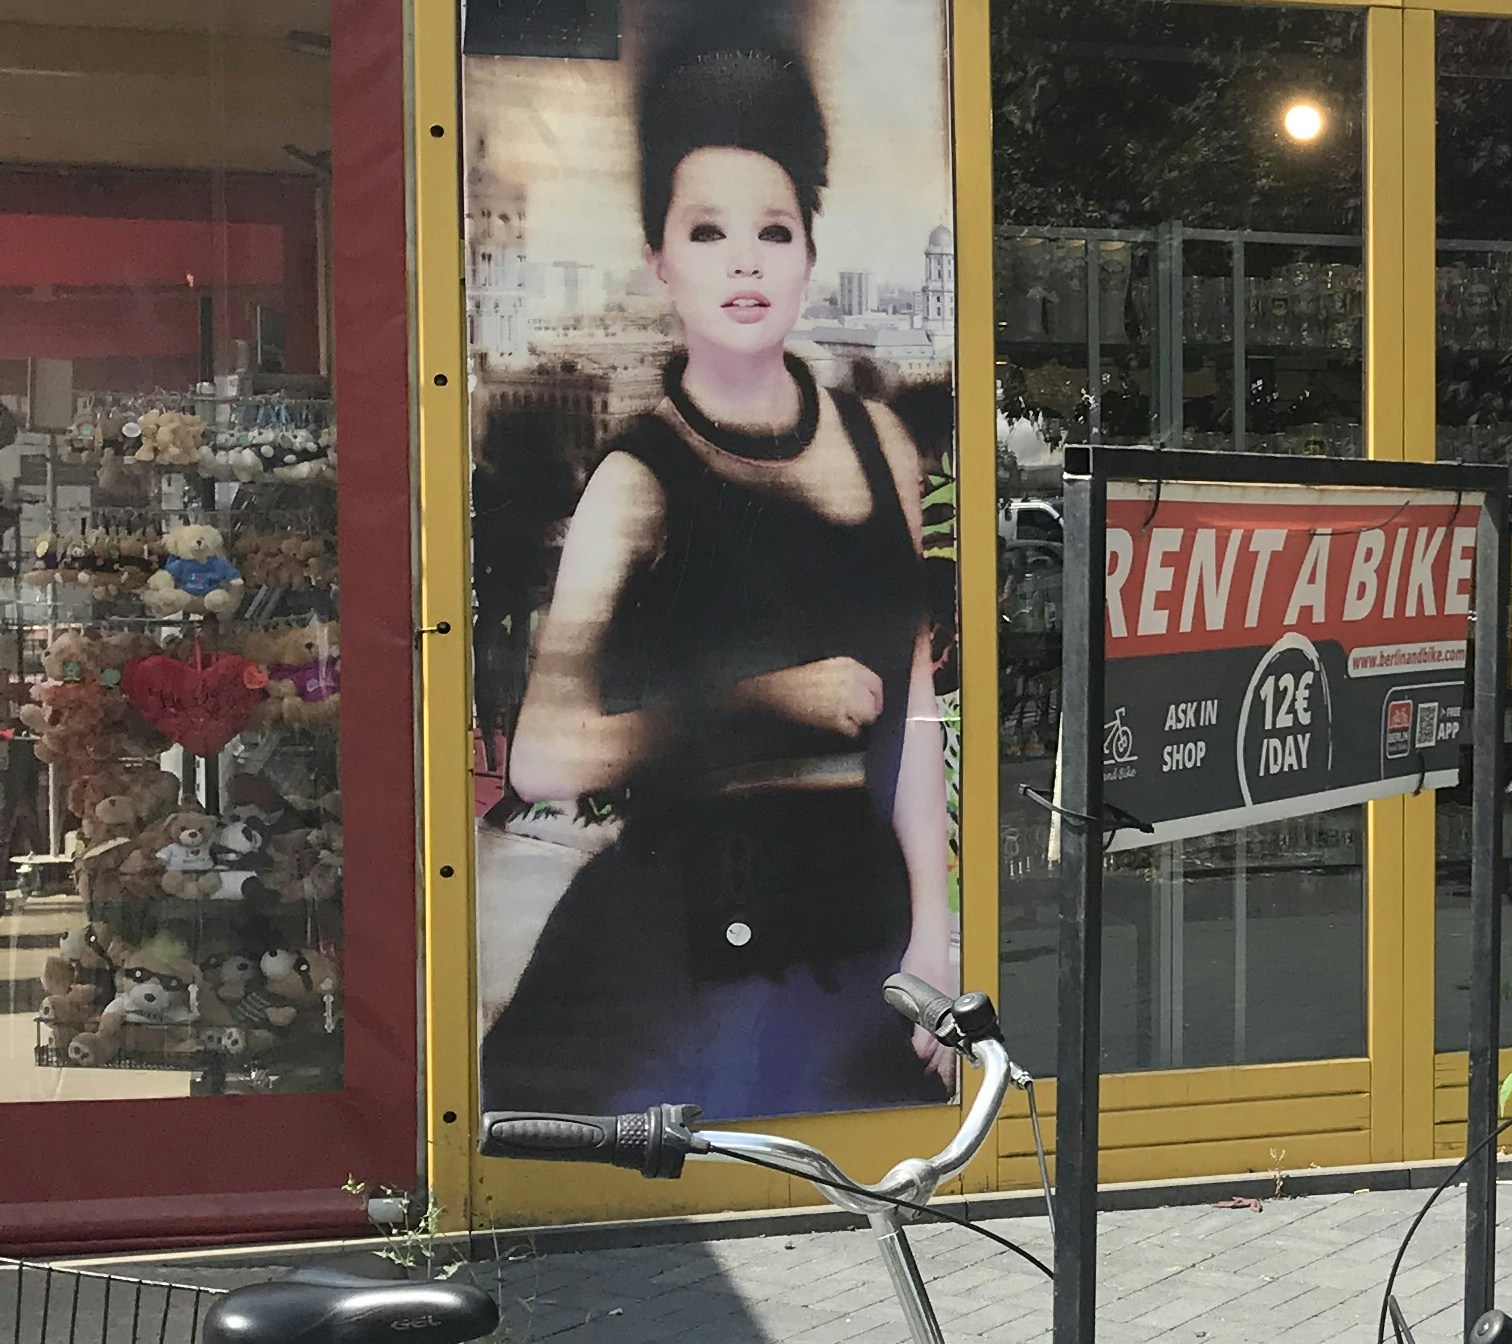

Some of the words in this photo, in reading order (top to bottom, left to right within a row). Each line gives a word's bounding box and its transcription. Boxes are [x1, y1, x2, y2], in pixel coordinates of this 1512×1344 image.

[1106, 527, 1287, 638] RENT
[1283, 527, 1332, 625] A
[1342, 525, 1477, 621] BIKE
[1352, 646, 1467, 671] www.berlinandbike.com
[1164, 703, 1196, 731] ASK
[1199, 699, 1218, 726] IN
[1259, 671, 1314, 730] 12€
[1437, 722, 1460, 740] APP
[1162, 740, 1206, 772] SHOP
[1258, 733, 1311, 777] /DAY
[390, 1314, 442, 1331] GEL
